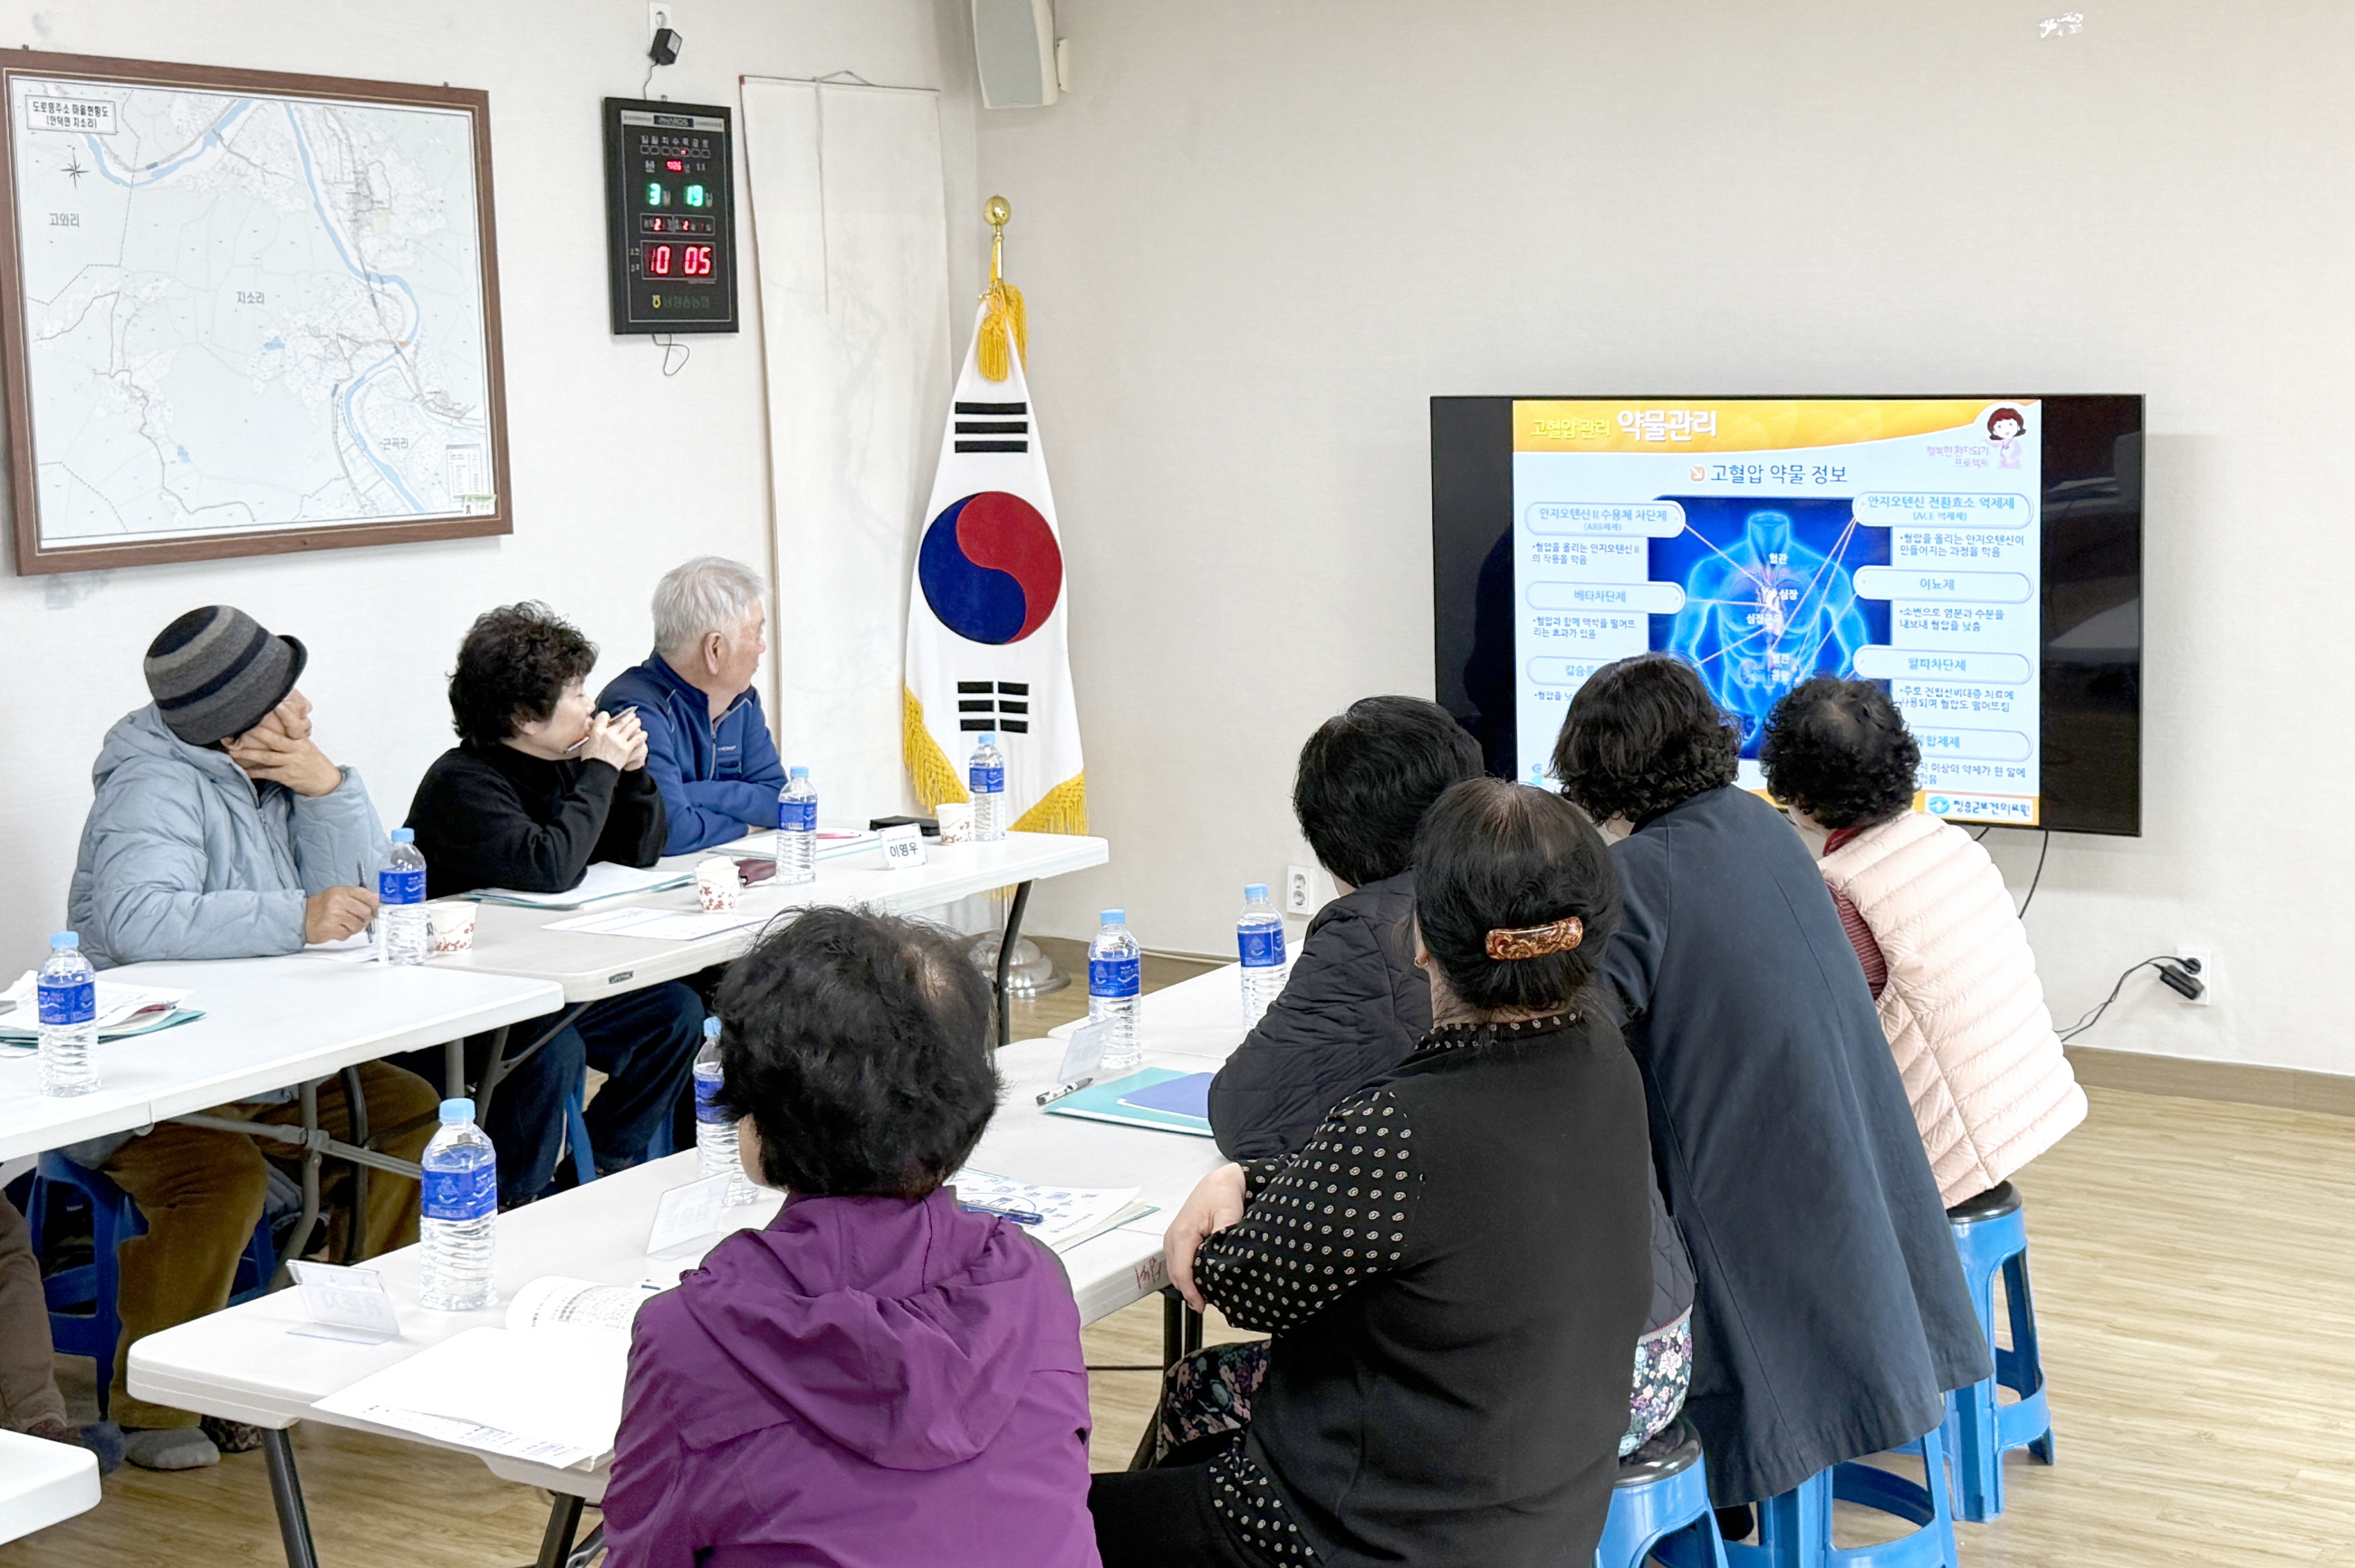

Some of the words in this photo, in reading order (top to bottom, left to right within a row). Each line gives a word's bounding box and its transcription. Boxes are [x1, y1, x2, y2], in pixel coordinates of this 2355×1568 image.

[33, 101, 71, 114] 도로명주소
[649, 182, 661, 207] 3
[686, 184, 704, 207] 19
[49, 212, 80, 227] 고와리
[650, 245, 670, 274] 10
[684, 245, 712, 274] 05
[236, 291, 264, 304] 지소리
[1530, 418, 1578, 440] 고혈압
[1579, 418, 1611, 440] 관리
[1616, 409, 1718, 443] 약물관리
[1953, 457, 1990, 468] 프로젝트
[1710, 464, 1765, 485] 고혈압
[1769, 464, 1807, 485] 약물
[1811, 464, 1849, 486] 정보
[1868, 495, 1925, 509] 안지오텐신
[1928, 495, 1976, 509] 전환효소
[1979, 496, 2014, 510] 억제제
[1539, 507, 1591, 521] 안지오텐신
[1600, 508, 1633, 522] 수용체
[1635, 509, 1668, 522] 차단제
[1912, 511, 1935, 521] (ACE
[1903, 533, 1932, 544] 혈압을
[1934, 533, 1964, 545] 올리는
[1966, 534, 2025, 546] 안지오텐신이
[1535, 541, 1561, 553] 혈압을
[1562, 542, 1589, 553] 올리는
[1590, 543, 1633, 554] 안지오텐신
[1899, 544, 1948, 557] 만들어지는
[1949, 545, 1979, 558] 과정을
[1981, 545, 2002, 558] 막음
[1532, 553, 1541, 564] 의
[1543, 553, 1569, 565] 작용을
[1571, 553, 1588, 566] 막음
[1768, 552, 1789, 565] 혈관
[1919, 578, 1956, 592] 이뇨제
[1573, 590, 1627, 603] 베타차단제
[1778, 588, 1799, 601] 심장
[1903, 606, 1942, 618] 소변으로
[1944, 607, 1974, 620] 염분과
[1975, 608, 2005, 621] 수분을
[1535, 615, 1562, 627] 혈압과
[1563, 616, 1581, 628] 함께
[1582, 617, 1609, 629] 맥박을
[1899, 619, 1929, 630] 내보내
[1931, 619, 1960, 632] 혈압을
[1533, 626, 1551, 639] 리는
[1552, 627, 1578, 640] 효과가
[1579, 628, 1597, 640] 있음
[1908, 658, 1967, 672] 알파차단제
[889, 842, 918, 858] 이영우
